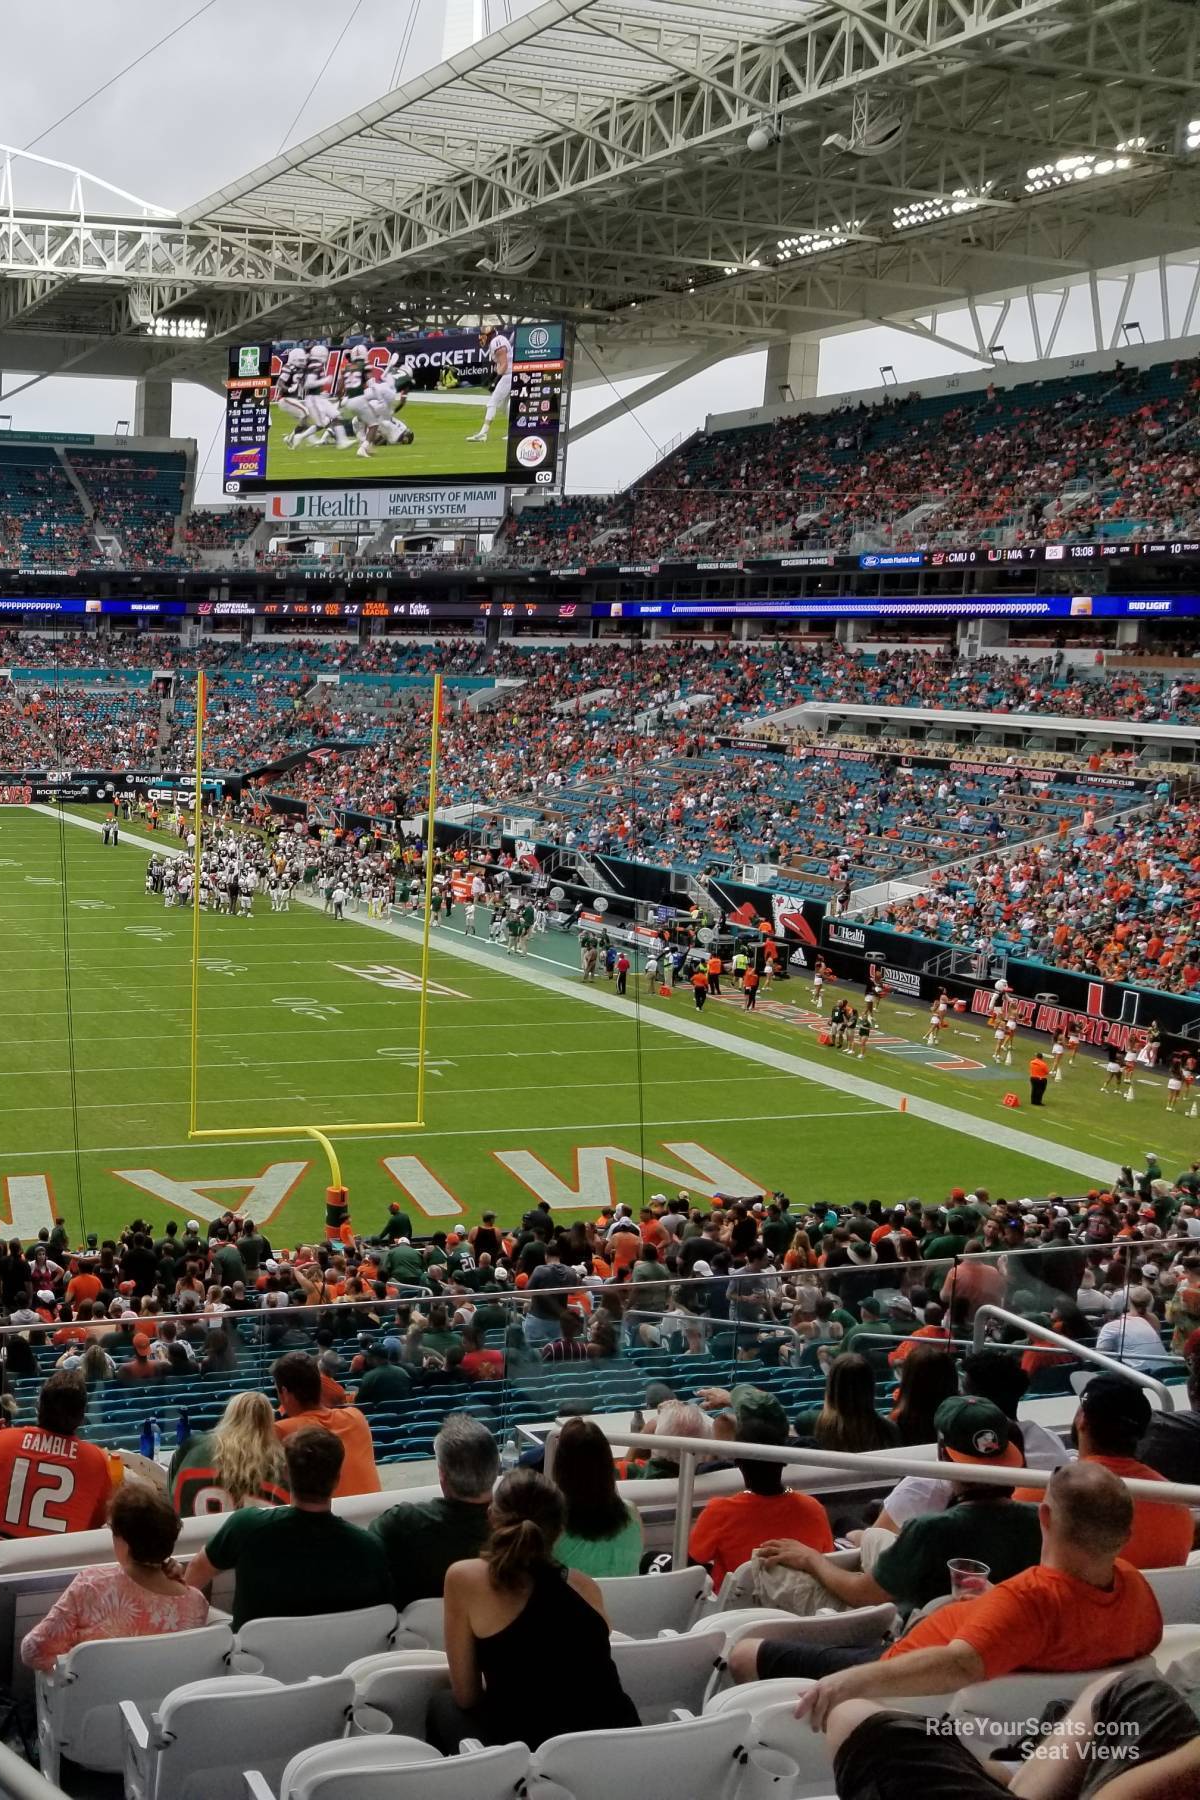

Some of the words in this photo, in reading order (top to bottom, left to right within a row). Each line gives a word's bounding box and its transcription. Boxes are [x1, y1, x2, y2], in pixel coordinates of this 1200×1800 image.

[404, 349, 476, 369] ROCKET
[537, 473, 550, 481] CC
[227, 483, 238, 491] CC
[389, 492, 446, 503] UNIVERSITY
[447, 492, 461, 501] OF
[463, 490, 497, 501] MIAMI
[388, 505, 426, 515] HEALTH
[427, 504, 466, 514] SYSTEM
[1071, 546, 1093, 557] 13:08
[1104, 546, 1116, 554] 2ND
[1142, 545, 1147, 553] 1
[1170, 544, 1181, 553] 10
[949, 552, 967, 562] CMU
[970, 552, 976, 561] 0
[1007, 550, 1023, 559] MIA
[1029, 549, 1035, 558] 7
[304, 571, 335, 579] RING
[347, 571, 392, 579] HONOR
[311, 605, 321, 613] 19
[344, 605, 358, 613] 2.7
[394, 605, 404, 613] #4
[1129, 602, 1145, 610] BUD
[789, 956, 808, 967] adidas
[884, 967, 921, 987] SYLVESTER
[460, 1257, 476, 1273] 20
[21, 1432, 78, 1460] GAMBLE
[4, 1457, 76, 1533] 12
